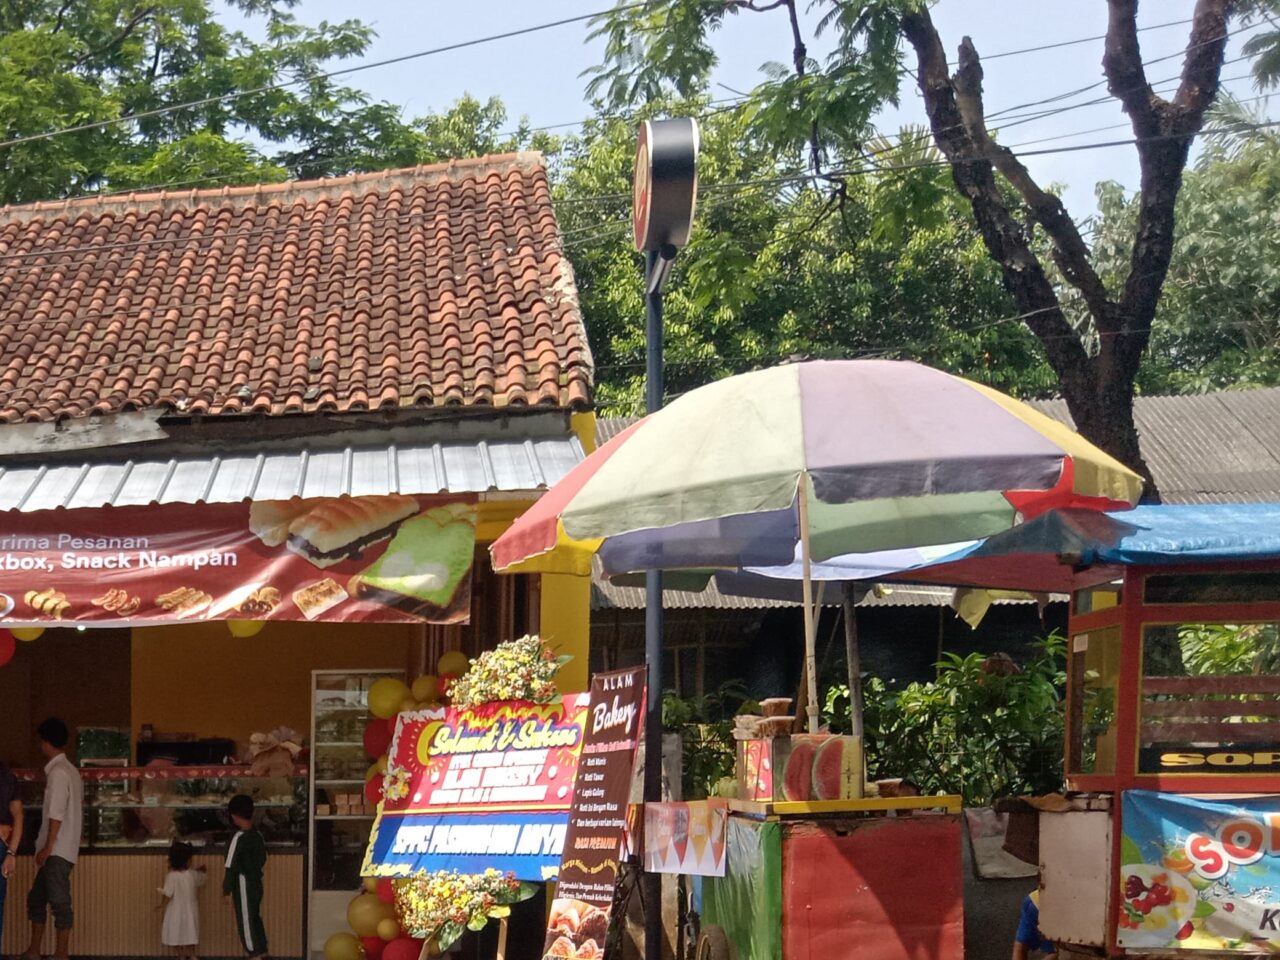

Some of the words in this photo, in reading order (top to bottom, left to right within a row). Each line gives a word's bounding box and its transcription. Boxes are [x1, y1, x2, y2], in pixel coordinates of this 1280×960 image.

[57, 533, 149, 549] Pesanan
[61, 551, 131, 569] Snack
[139, 549, 237, 573] Nampan
[603, 674, 633, 691] ALAM
[592, 695, 637, 736] Bakery
[1259, 908, 1280, 931] K
